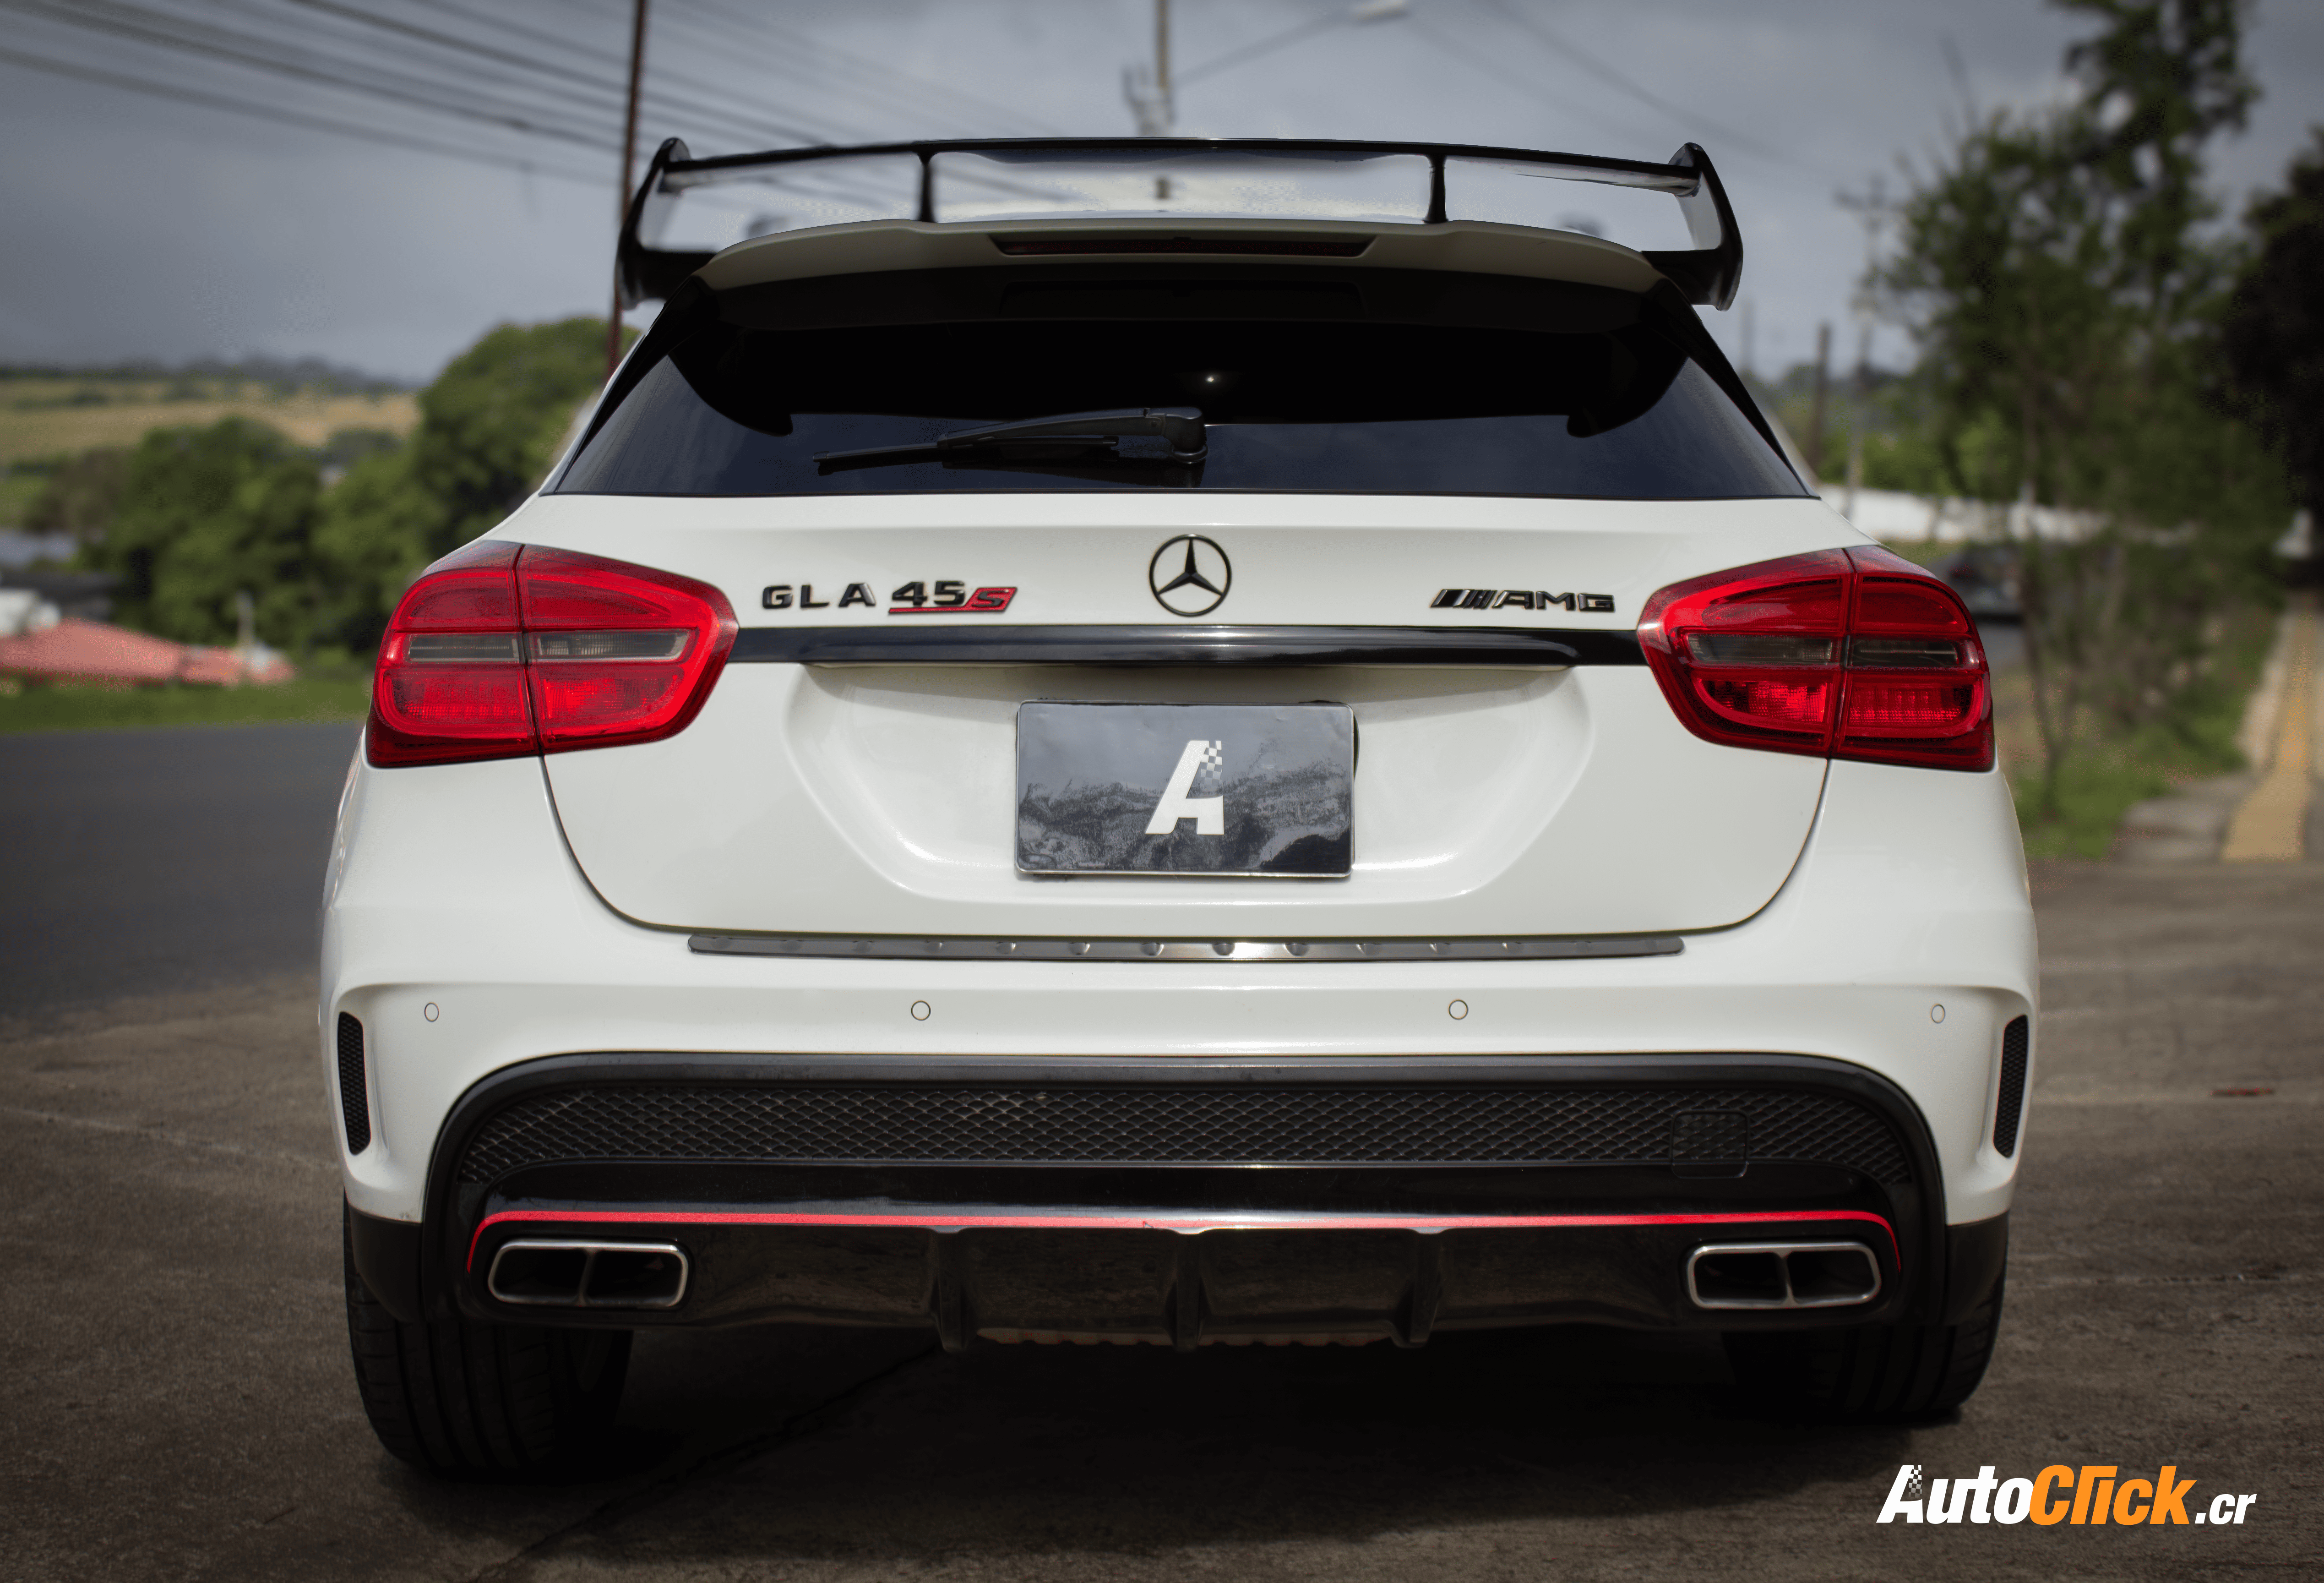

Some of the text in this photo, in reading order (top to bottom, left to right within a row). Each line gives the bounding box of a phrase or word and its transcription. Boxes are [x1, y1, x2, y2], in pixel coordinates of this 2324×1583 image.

[762, 582, 876, 609] GLA
[1491, 590, 1616, 613] AMG
[1145, 740, 1225, 835] A
